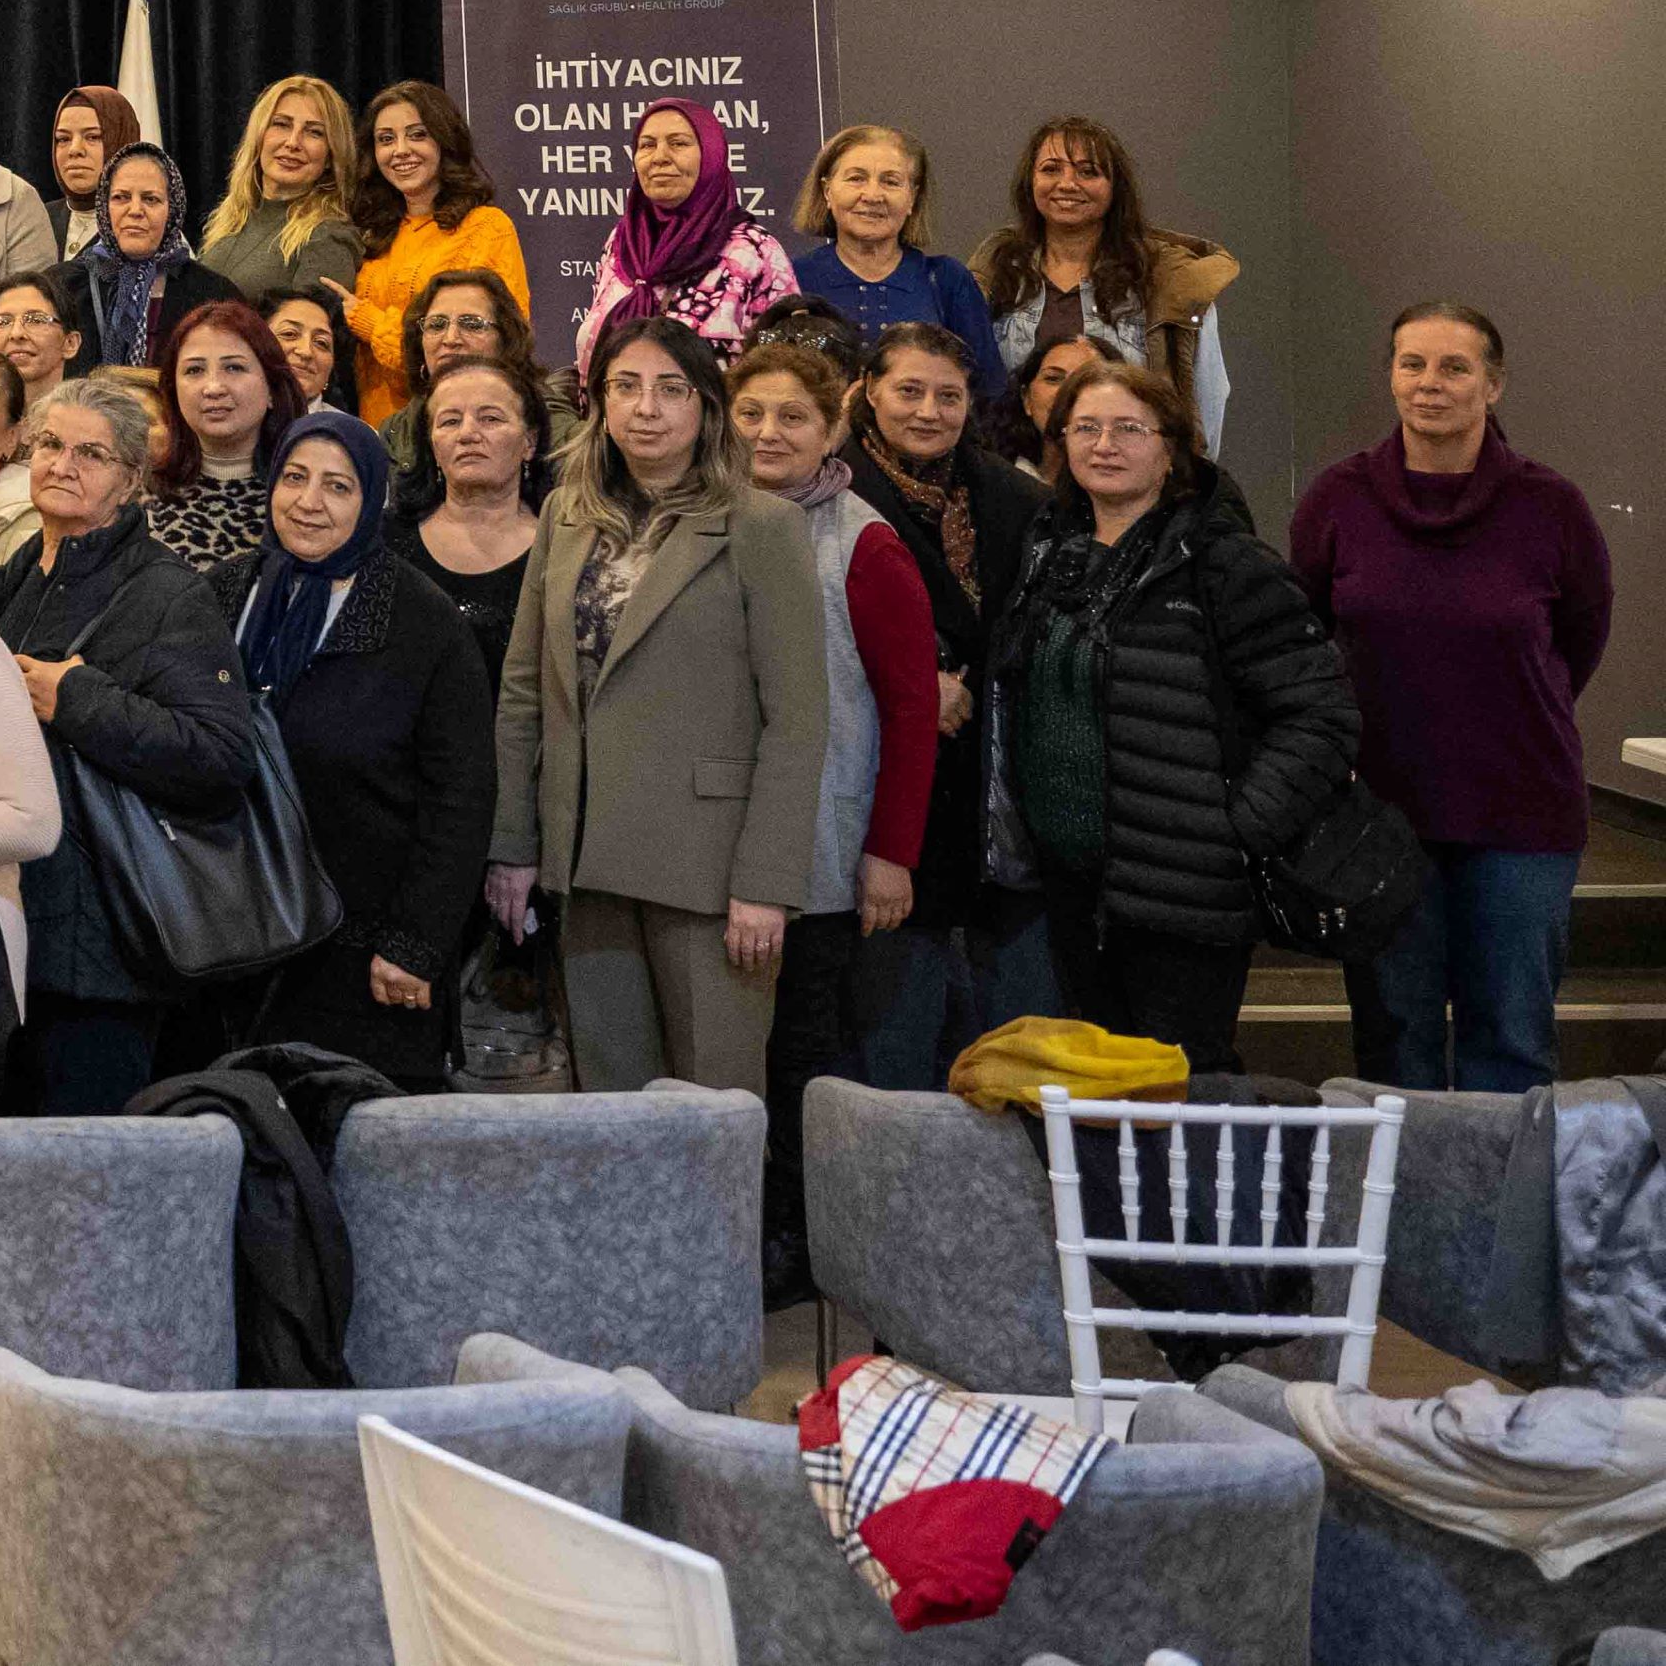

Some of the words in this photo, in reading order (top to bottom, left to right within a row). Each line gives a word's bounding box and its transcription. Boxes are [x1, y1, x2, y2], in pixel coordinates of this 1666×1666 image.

[589, 2, 630, 13] GRUBU
[637, 0, 681, 11] HEALTH
[535, 52, 744, 89] İHTİYACINIZ
[514, 102, 612, 132] OLAN
[541, 144, 613, 174] HER
